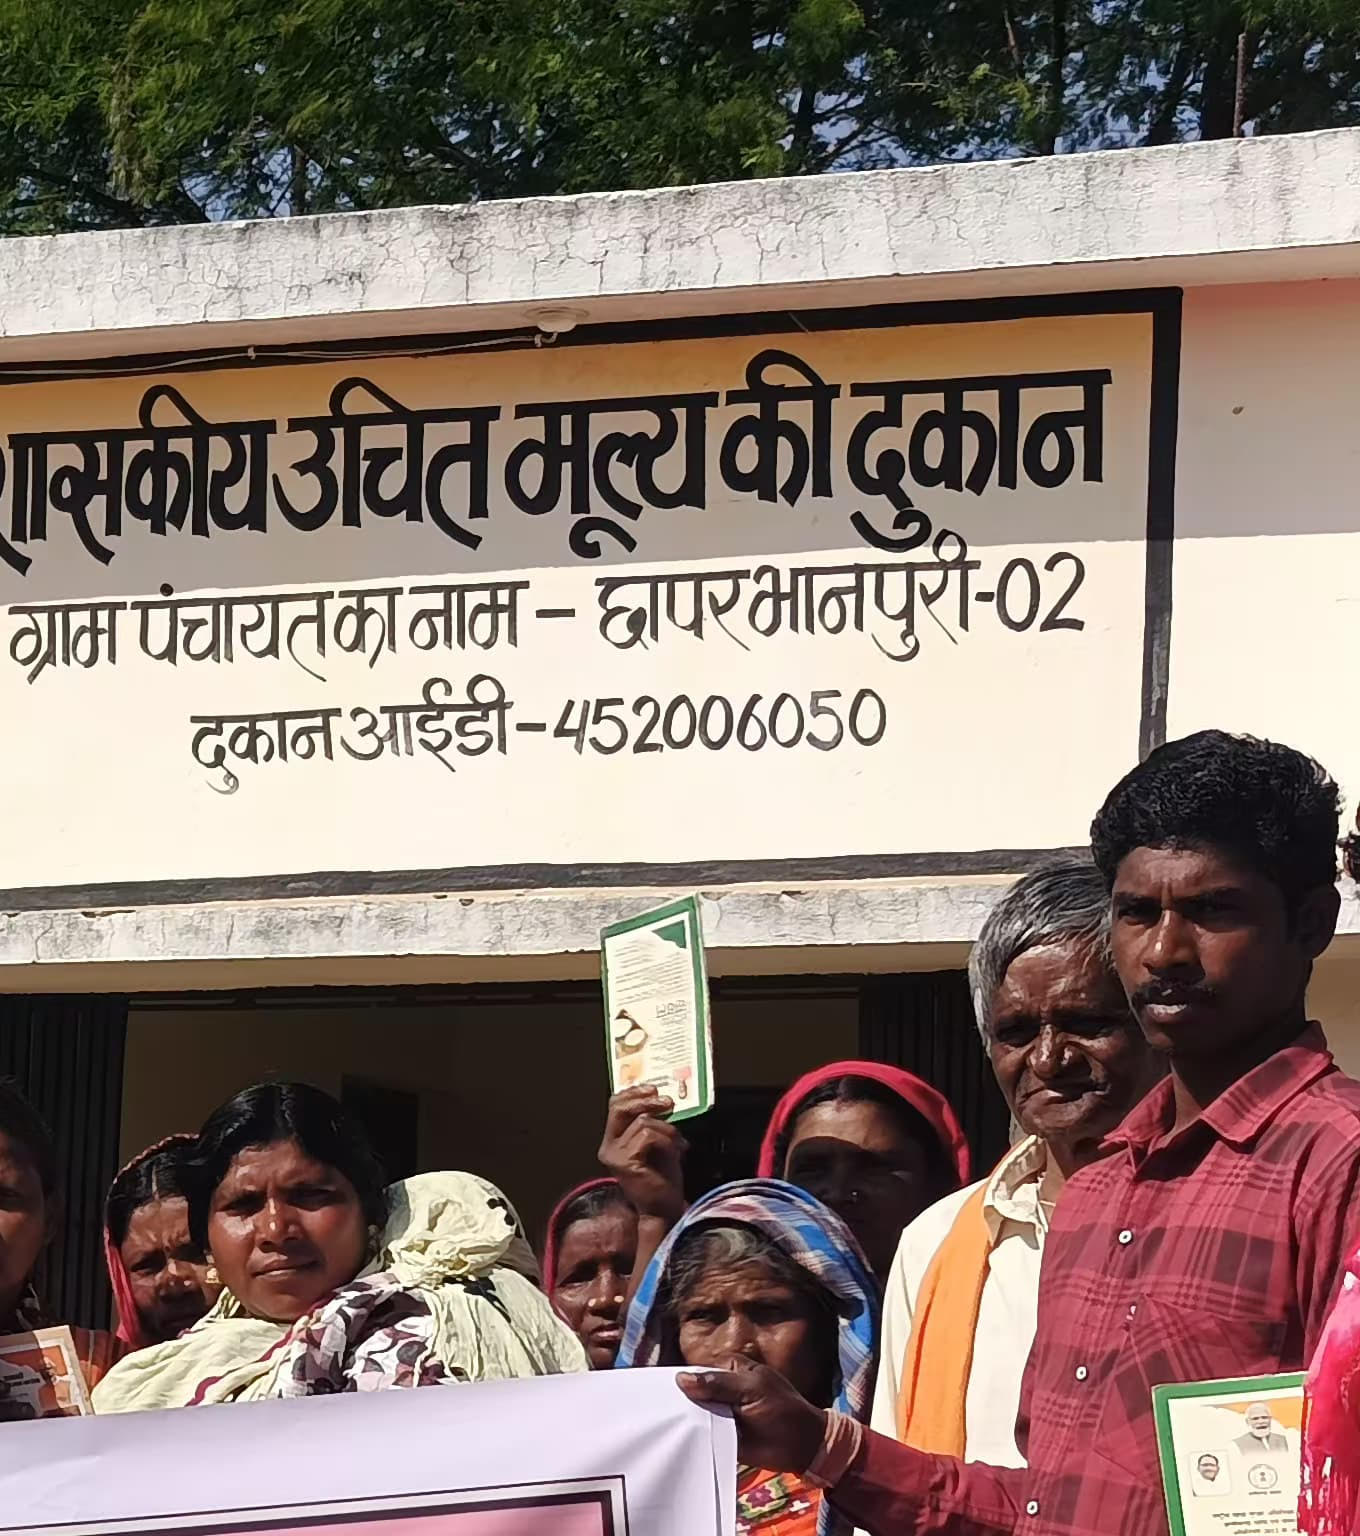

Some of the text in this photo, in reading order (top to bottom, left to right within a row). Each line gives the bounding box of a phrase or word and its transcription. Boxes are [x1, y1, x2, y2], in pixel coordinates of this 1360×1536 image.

[272, 376, 500, 550] उचित
[504, 392, 719, 557] मूल्य
[719, 348, 841, 506] की
[846, 368, 1112, 552] दुकान
[8, 601, 127, 684] ग्राम
[190, 707, 341, 795] दुकान
